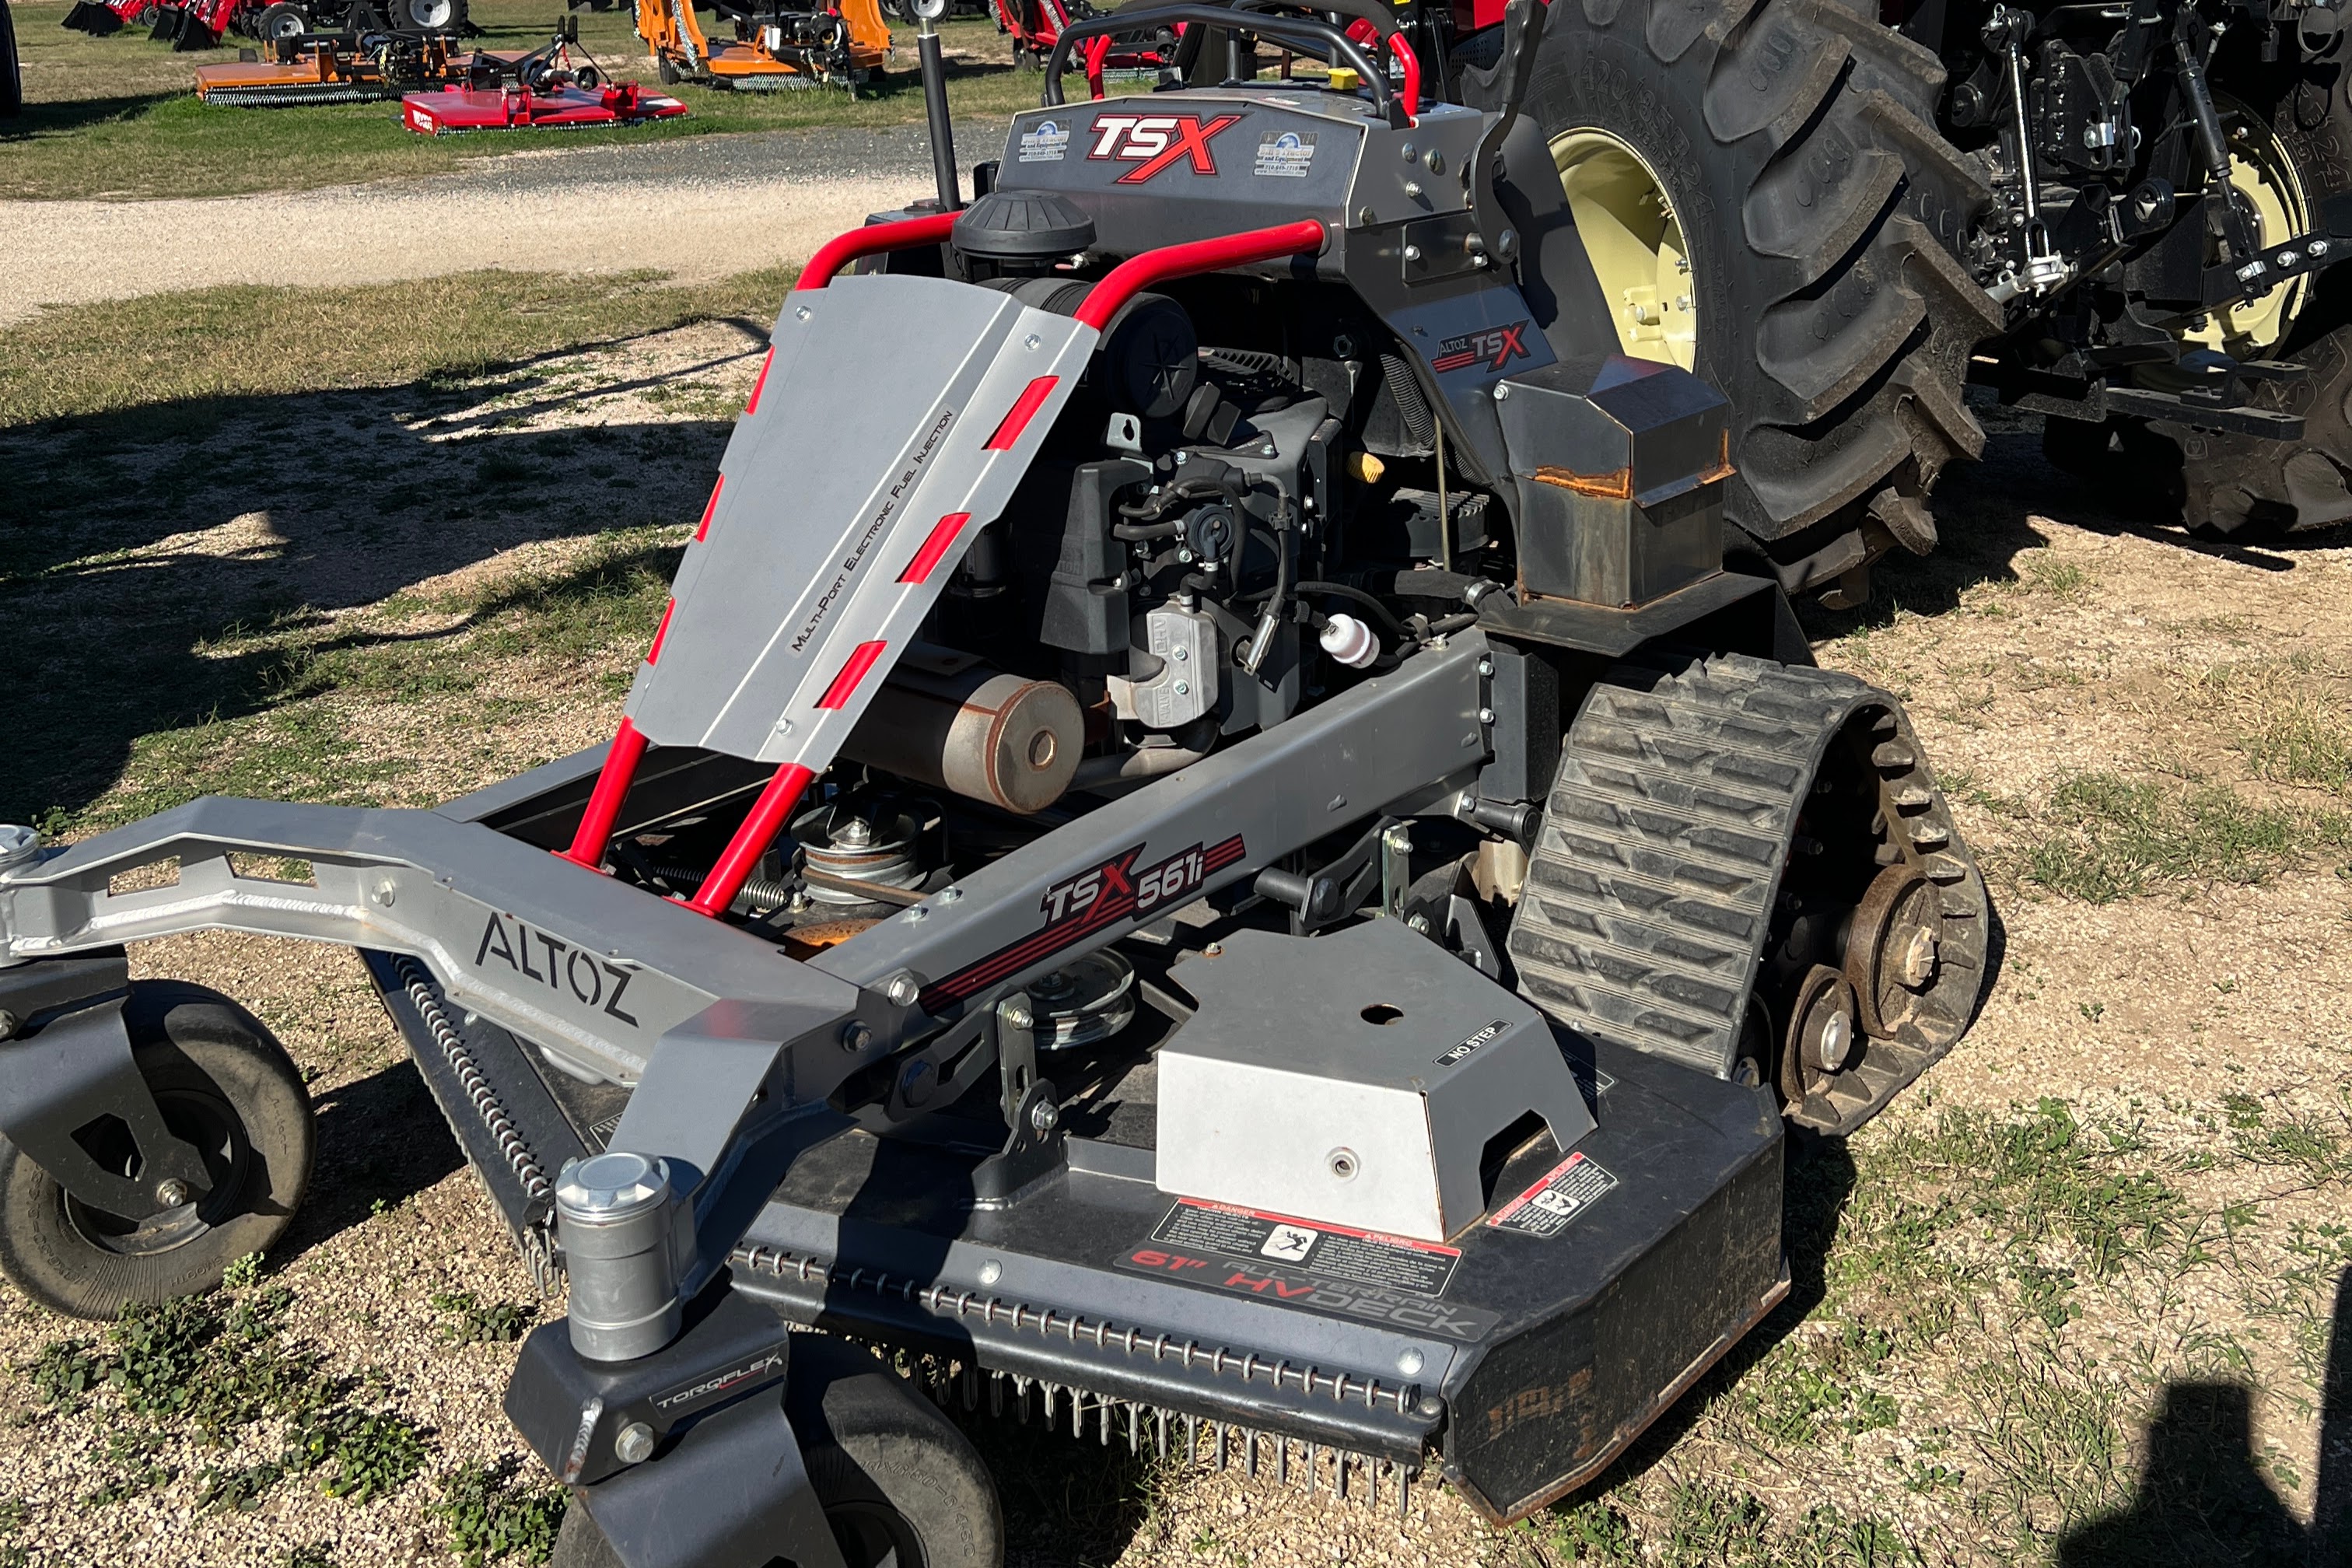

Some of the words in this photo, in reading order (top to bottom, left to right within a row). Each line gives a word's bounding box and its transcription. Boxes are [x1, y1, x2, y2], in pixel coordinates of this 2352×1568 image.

[1090, 115, 1241, 184] TSX
[1439, 338, 1468, 358] ALTOZ
[1472, 327, 1524, 365] TSX
[1046, 853, 1136, 925] TSX
[1136, 851, 1204, 909] 561i
[474, 911, 640, 1029] ALTOZ
[1447, 1045, 1471, 1059] NO
[1466, 1027, 1496, 1047] STEP
[1219, 1204, 1256, 1216] DANGER
[1223, 1261, 1458, 1316] ALL-TERRAIN
